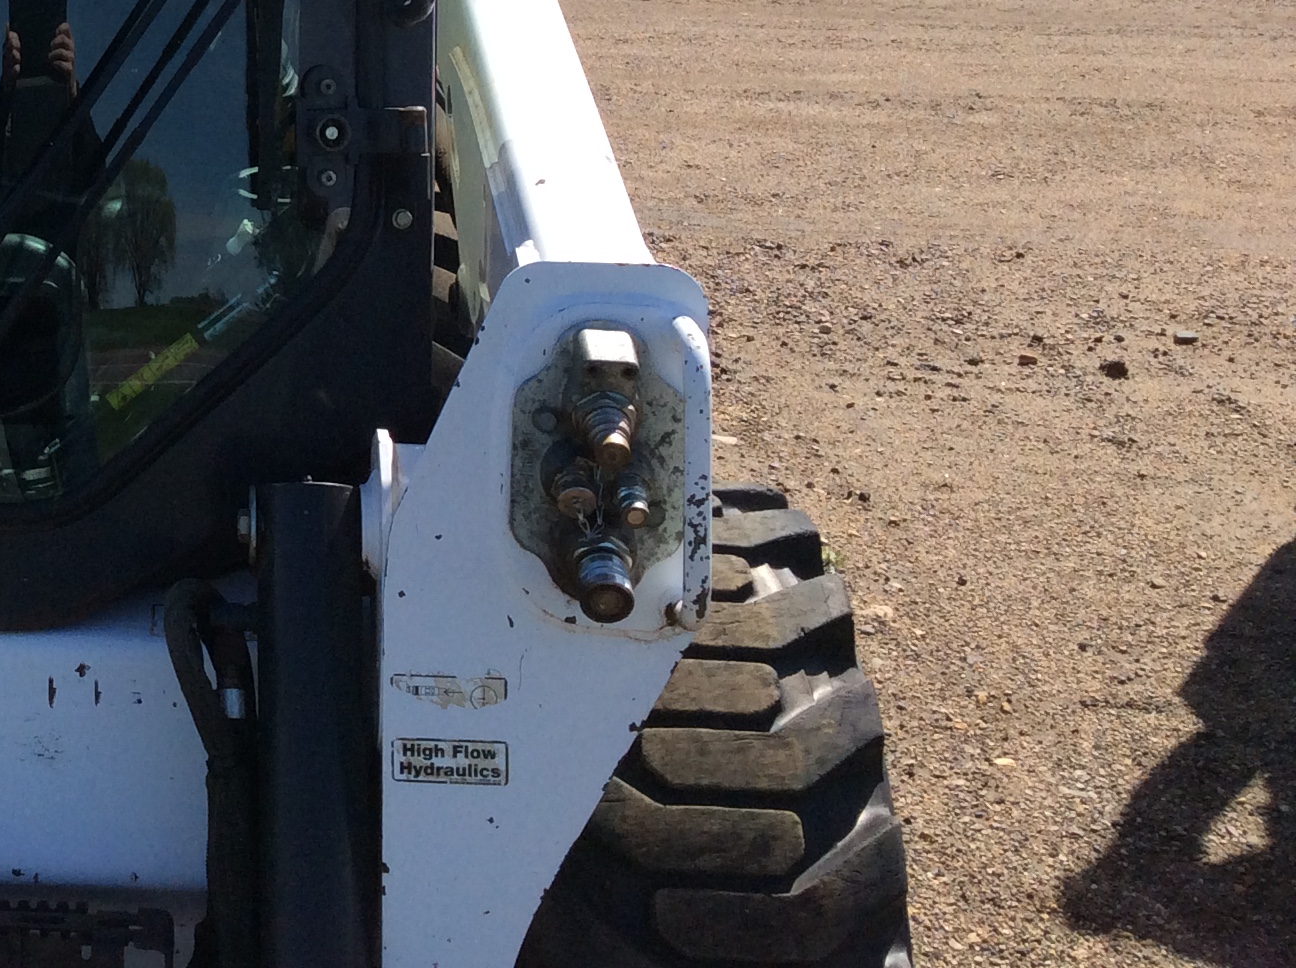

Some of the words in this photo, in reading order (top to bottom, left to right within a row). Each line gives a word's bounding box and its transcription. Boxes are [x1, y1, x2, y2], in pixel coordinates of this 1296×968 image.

[402, 743, 445, 760] High
[452, 745, 497, 759] Flow
[399, 761, 502, 778] Hydraulics
